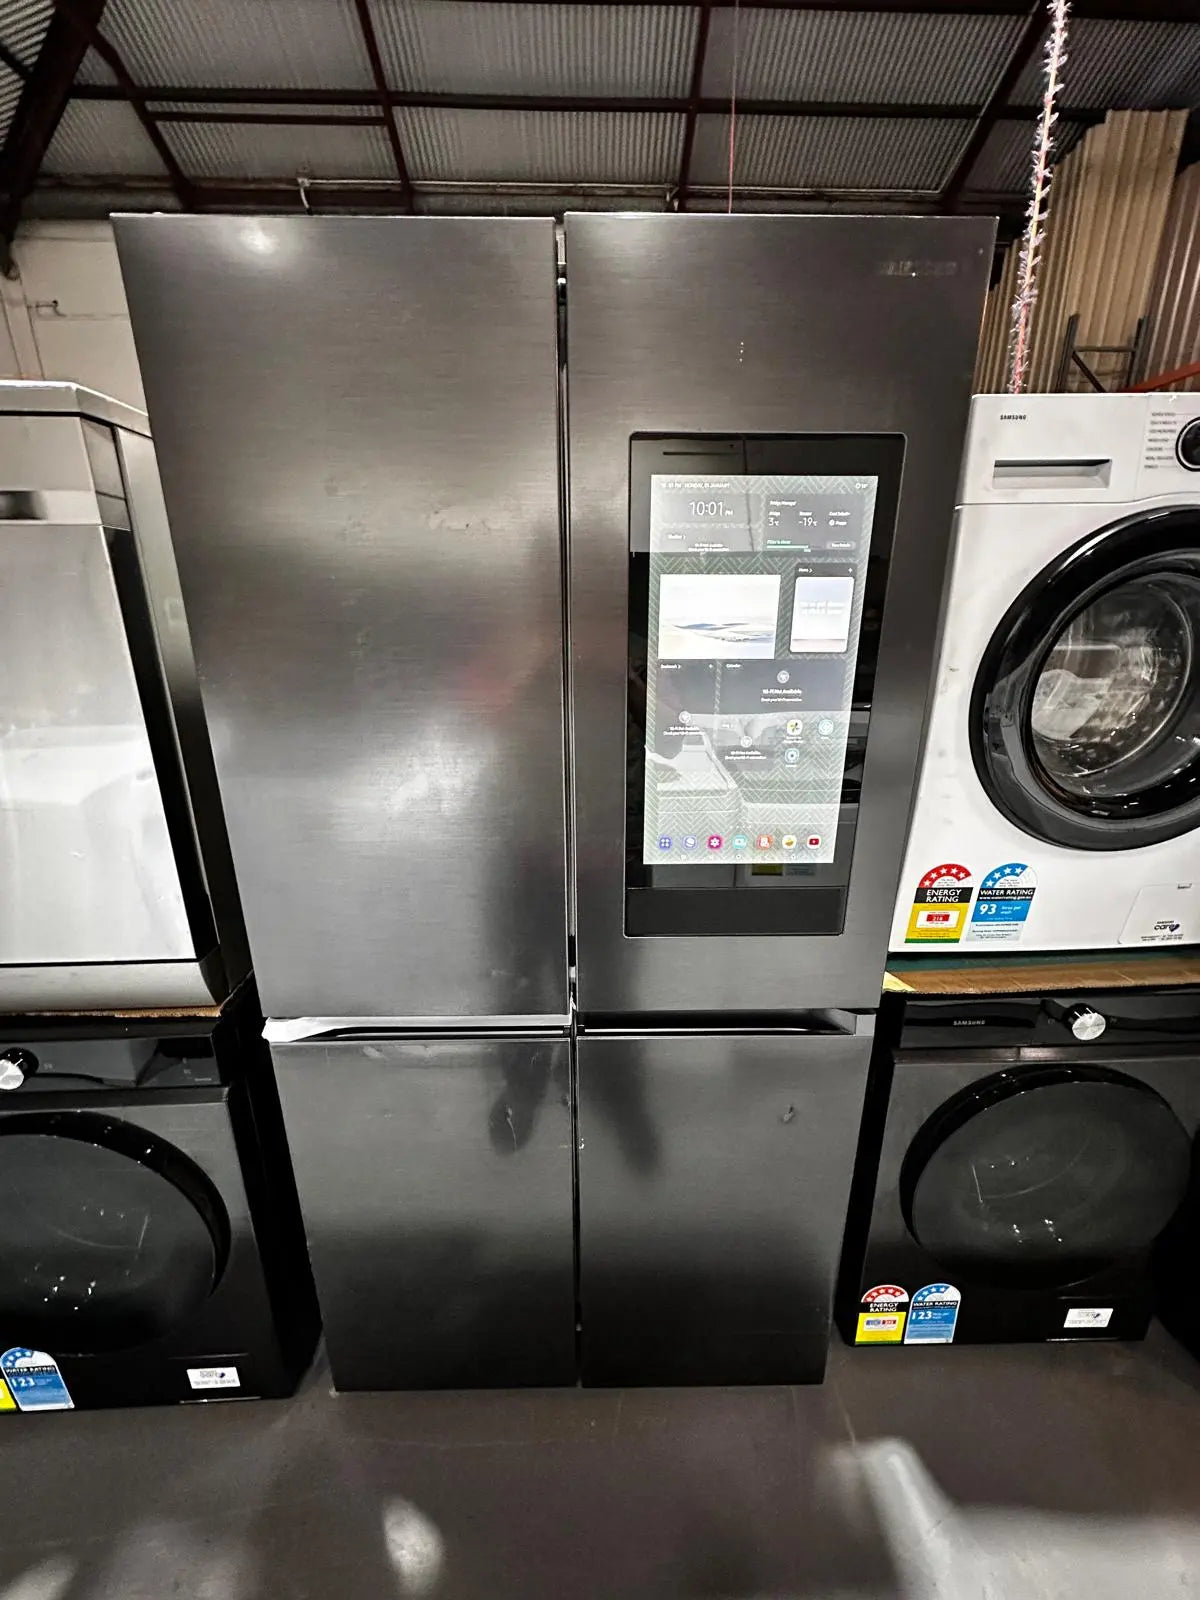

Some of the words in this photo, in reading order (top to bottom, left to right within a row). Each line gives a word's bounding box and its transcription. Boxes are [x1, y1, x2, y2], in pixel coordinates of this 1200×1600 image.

[689, 501, 723, 516] 10:01
[979, 903, 997, 915] 93
[911, 1311, 933, 1320] 123
